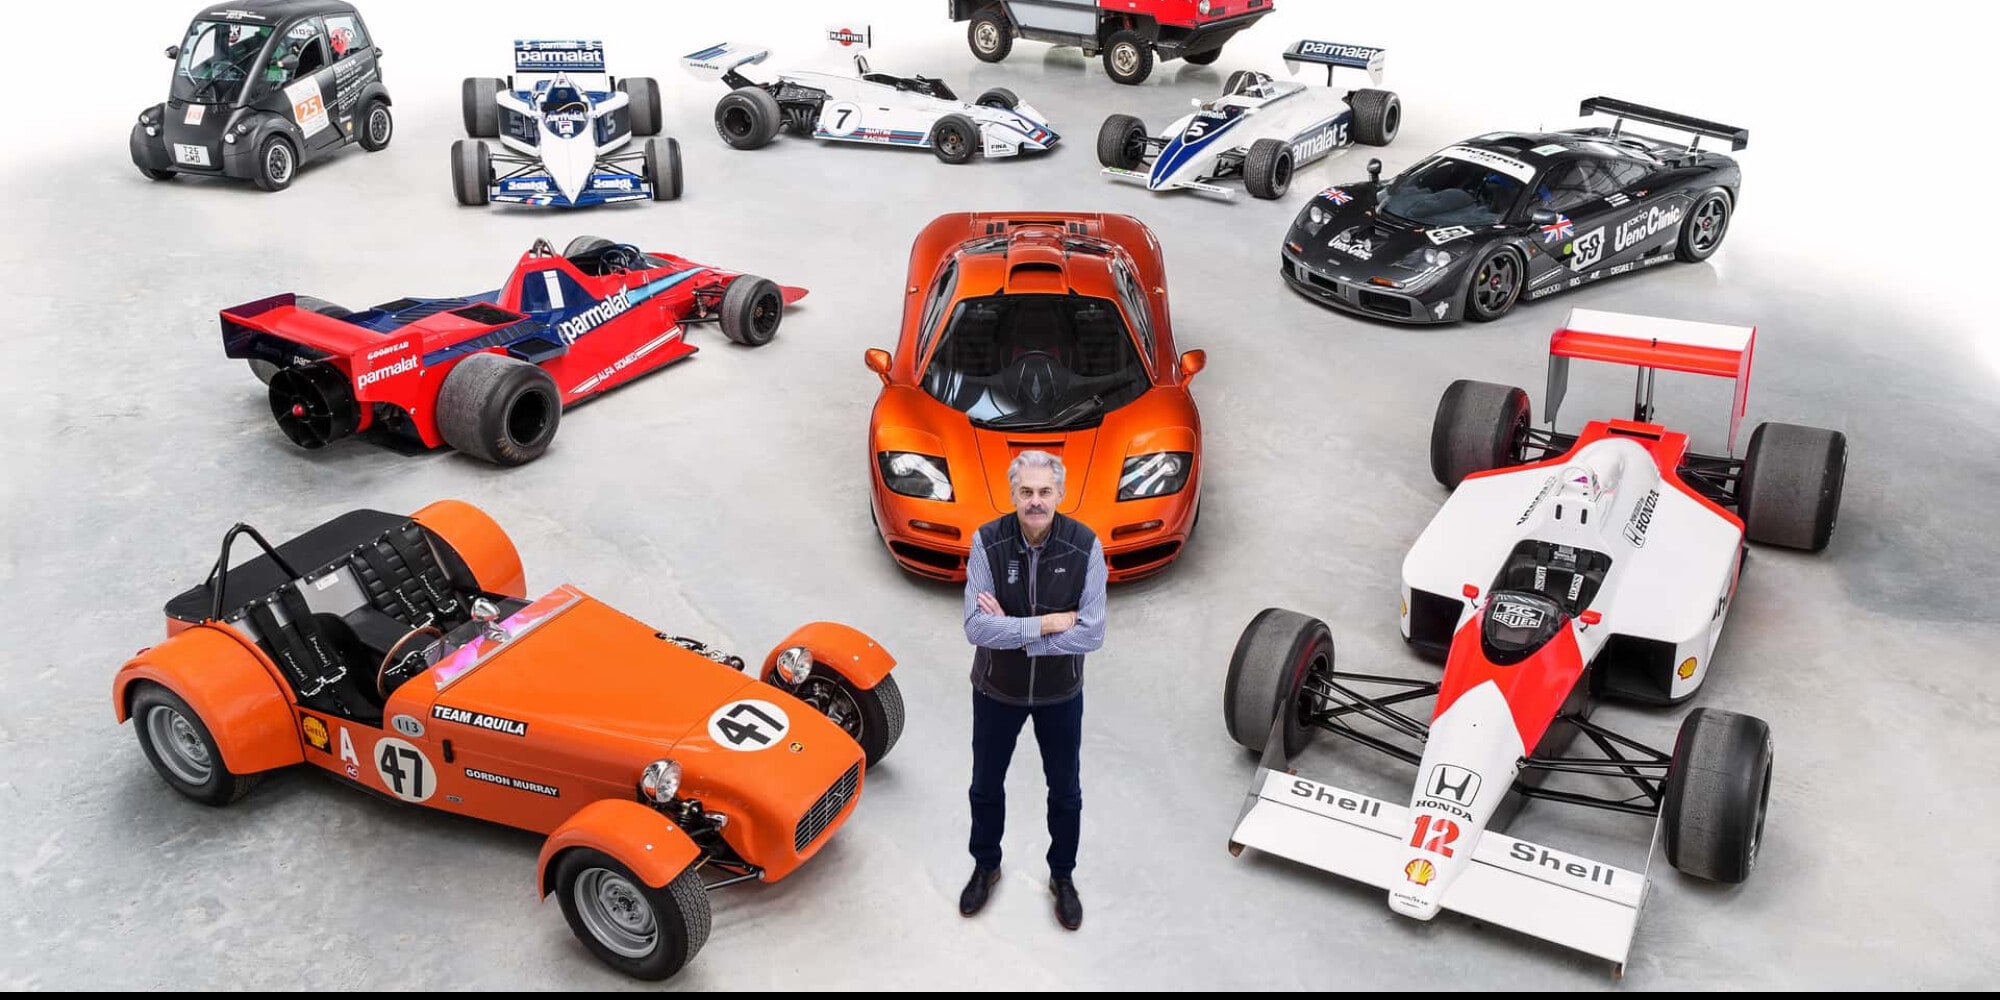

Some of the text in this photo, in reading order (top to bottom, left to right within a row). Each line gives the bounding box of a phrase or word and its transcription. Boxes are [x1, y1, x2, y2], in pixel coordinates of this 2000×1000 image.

[830, 31, 863, 43] MARTINI
[1301, 42, 1377, 60] parmalat
[517, 50, 600, 63] parmalat
[299, 98, 318, 118] 25
[836, 109, 852, 129] 7
[607, 112, 616, 135] 5
[1010, 119, 1028, 131] 7
[1187, 122, 1208, 136] 5
[1292, 122, 1348, 163] armalat 5
[1614, 204, 1680, 252] Ueno Clinic
[1576, 234, 1600, 264] 59
[1532, 283, 1561, 298] KENWOOD
[560, 284, 631, 344] parmalat
[367, 341, 409, 360] GOODYEAR
[357, 354, 418, 391] parmalat
[598, 352, 639, 381] ALFA ROMEO
[1636, 489, 1659, 535] HONDA
[1494, 613, 1540, 626] HEUER
[1502, 604, 1537, 618] TAG
[397, 719, 419, 733] 113
[434, 706, 526, 736] TEAM AQUILA
[714, 703, 786, 746] 47
[340, 726, 360, 766] A
[381, 744, 423, 798] 47
[465, 768, 558, 797] GORDON MURRAY
[1290, 780, 1382, 818] Shell
[1416, 800, 1474, 823] HONDA
[1409, 814, 1461, 859] 12
[1510, 842, 1614, 886] Shell
